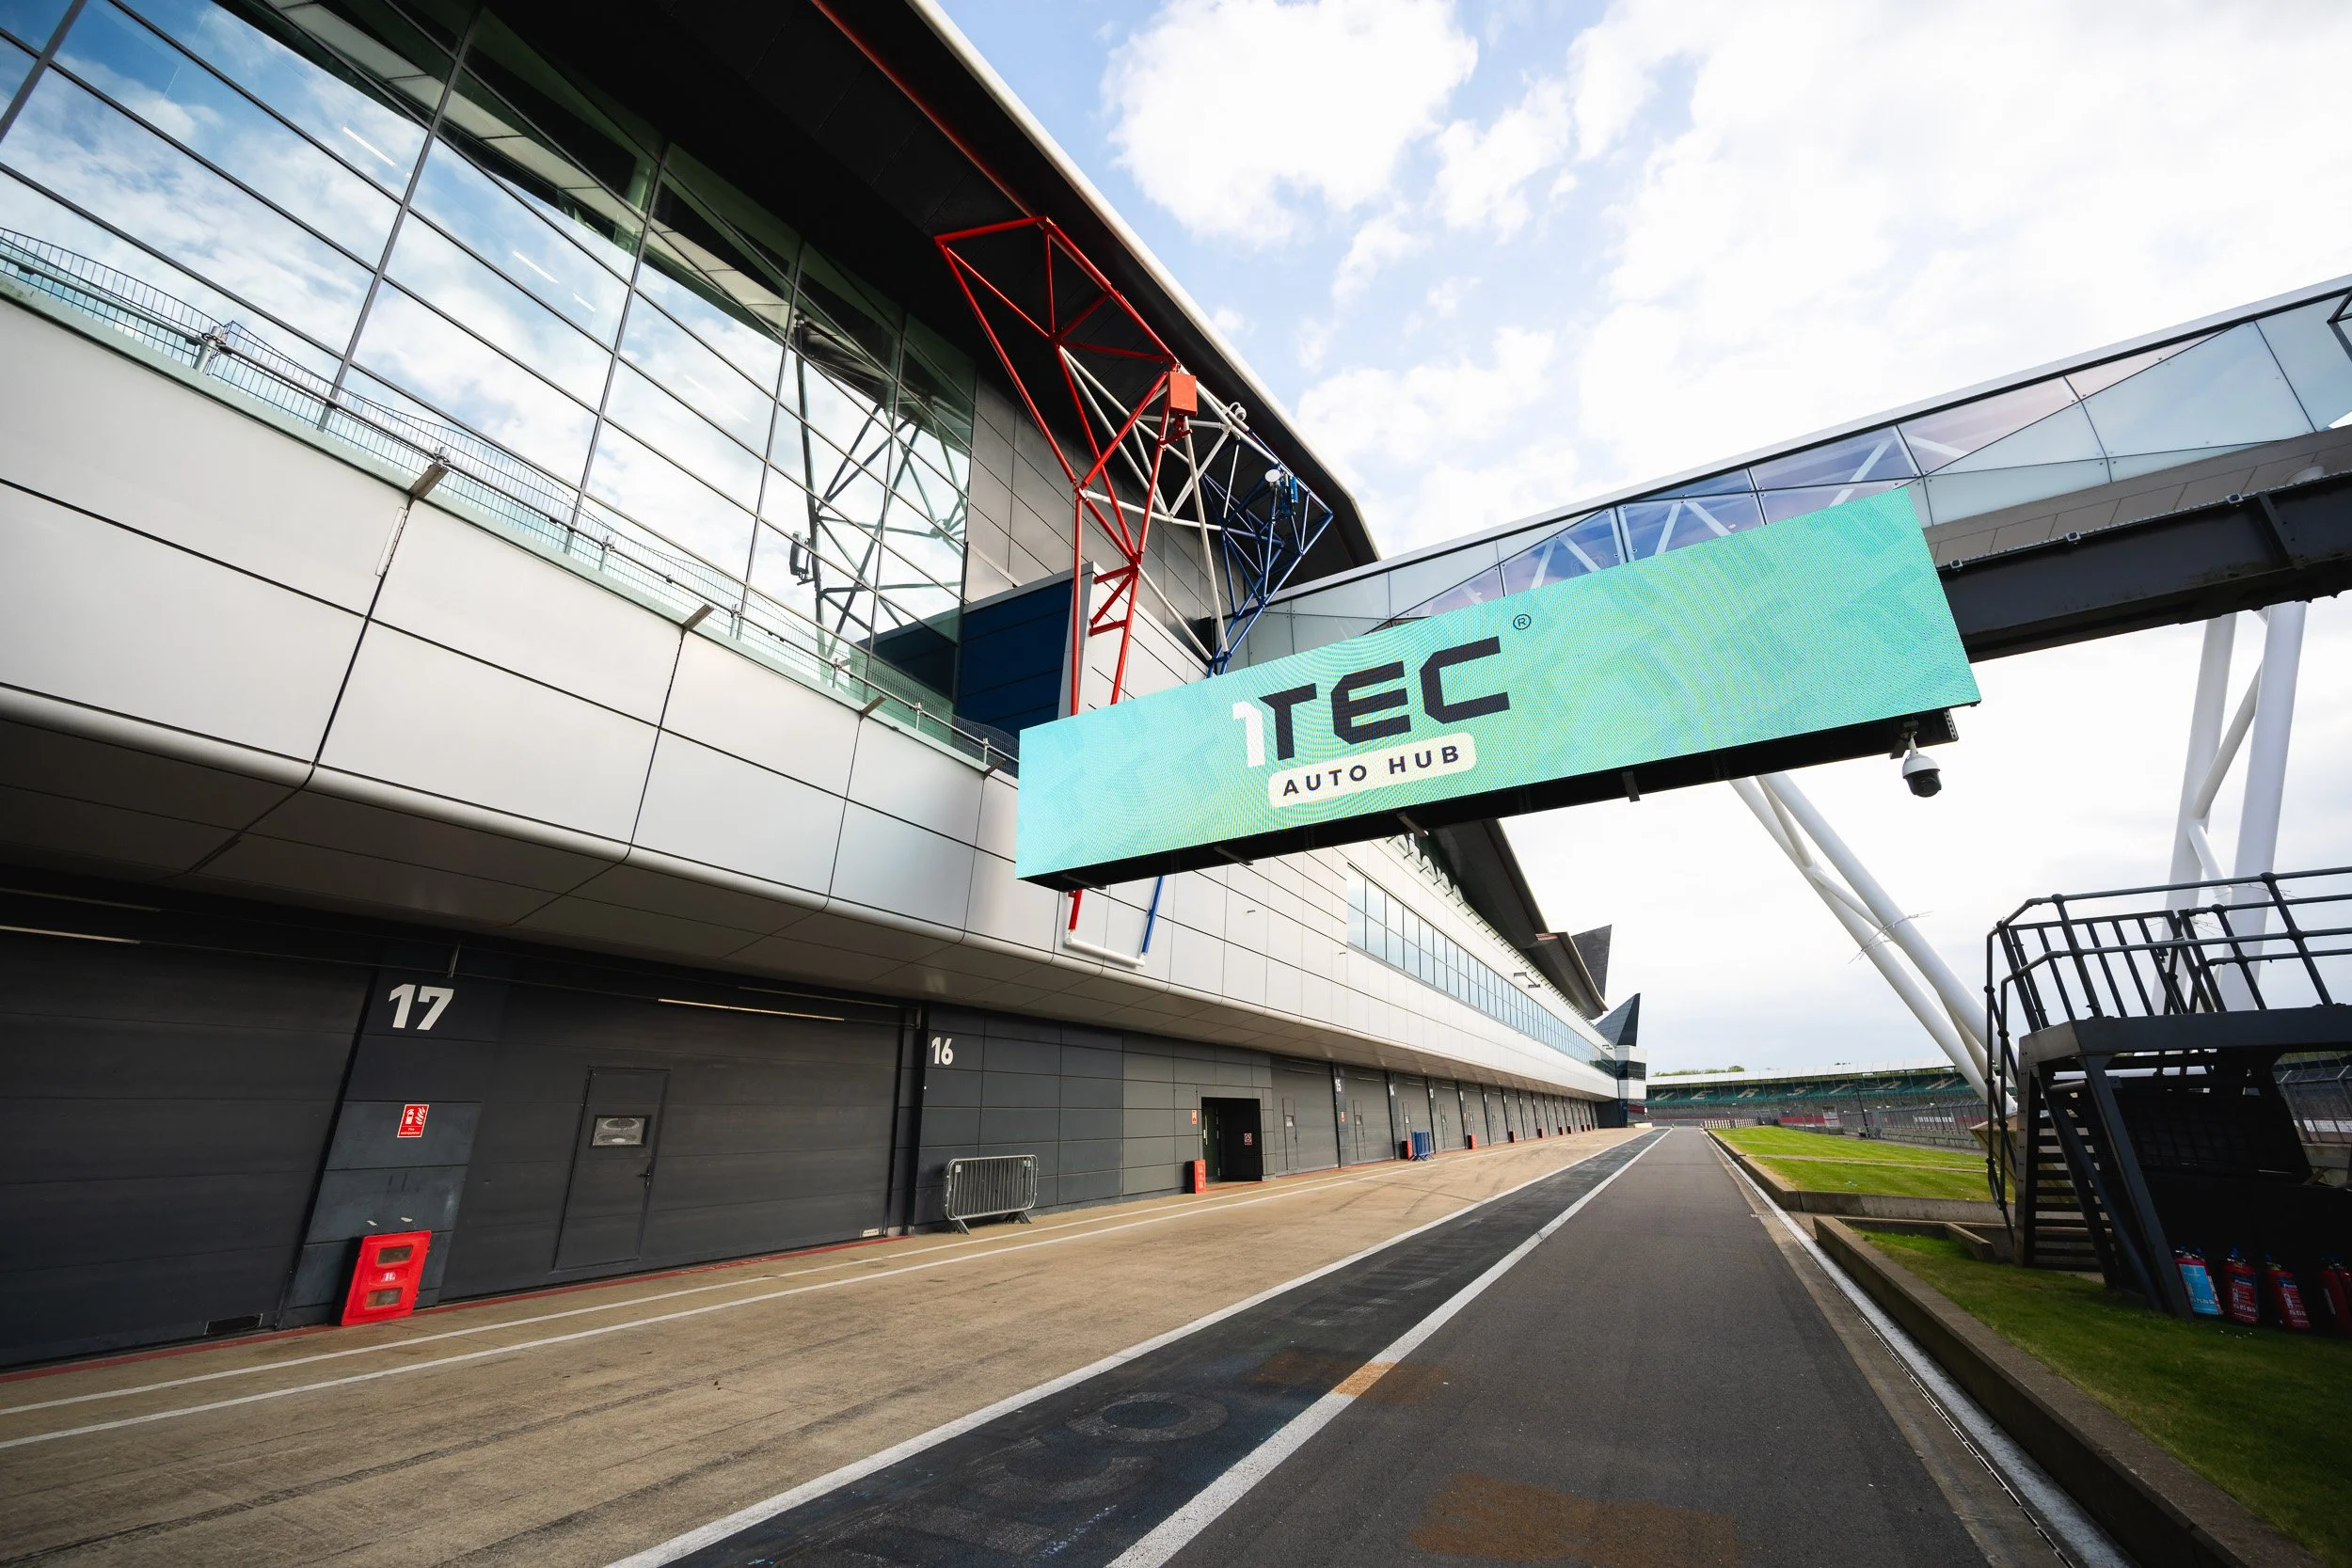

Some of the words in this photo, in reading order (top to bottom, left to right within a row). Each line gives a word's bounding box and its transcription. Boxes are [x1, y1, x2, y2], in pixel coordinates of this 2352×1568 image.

[1282, 765, 1367, 797] AUTO
[1388, 745, 1459, 774] HUB
[389, 983, 454, 1031] 17
[931, 1037, 954, 1066] 16
